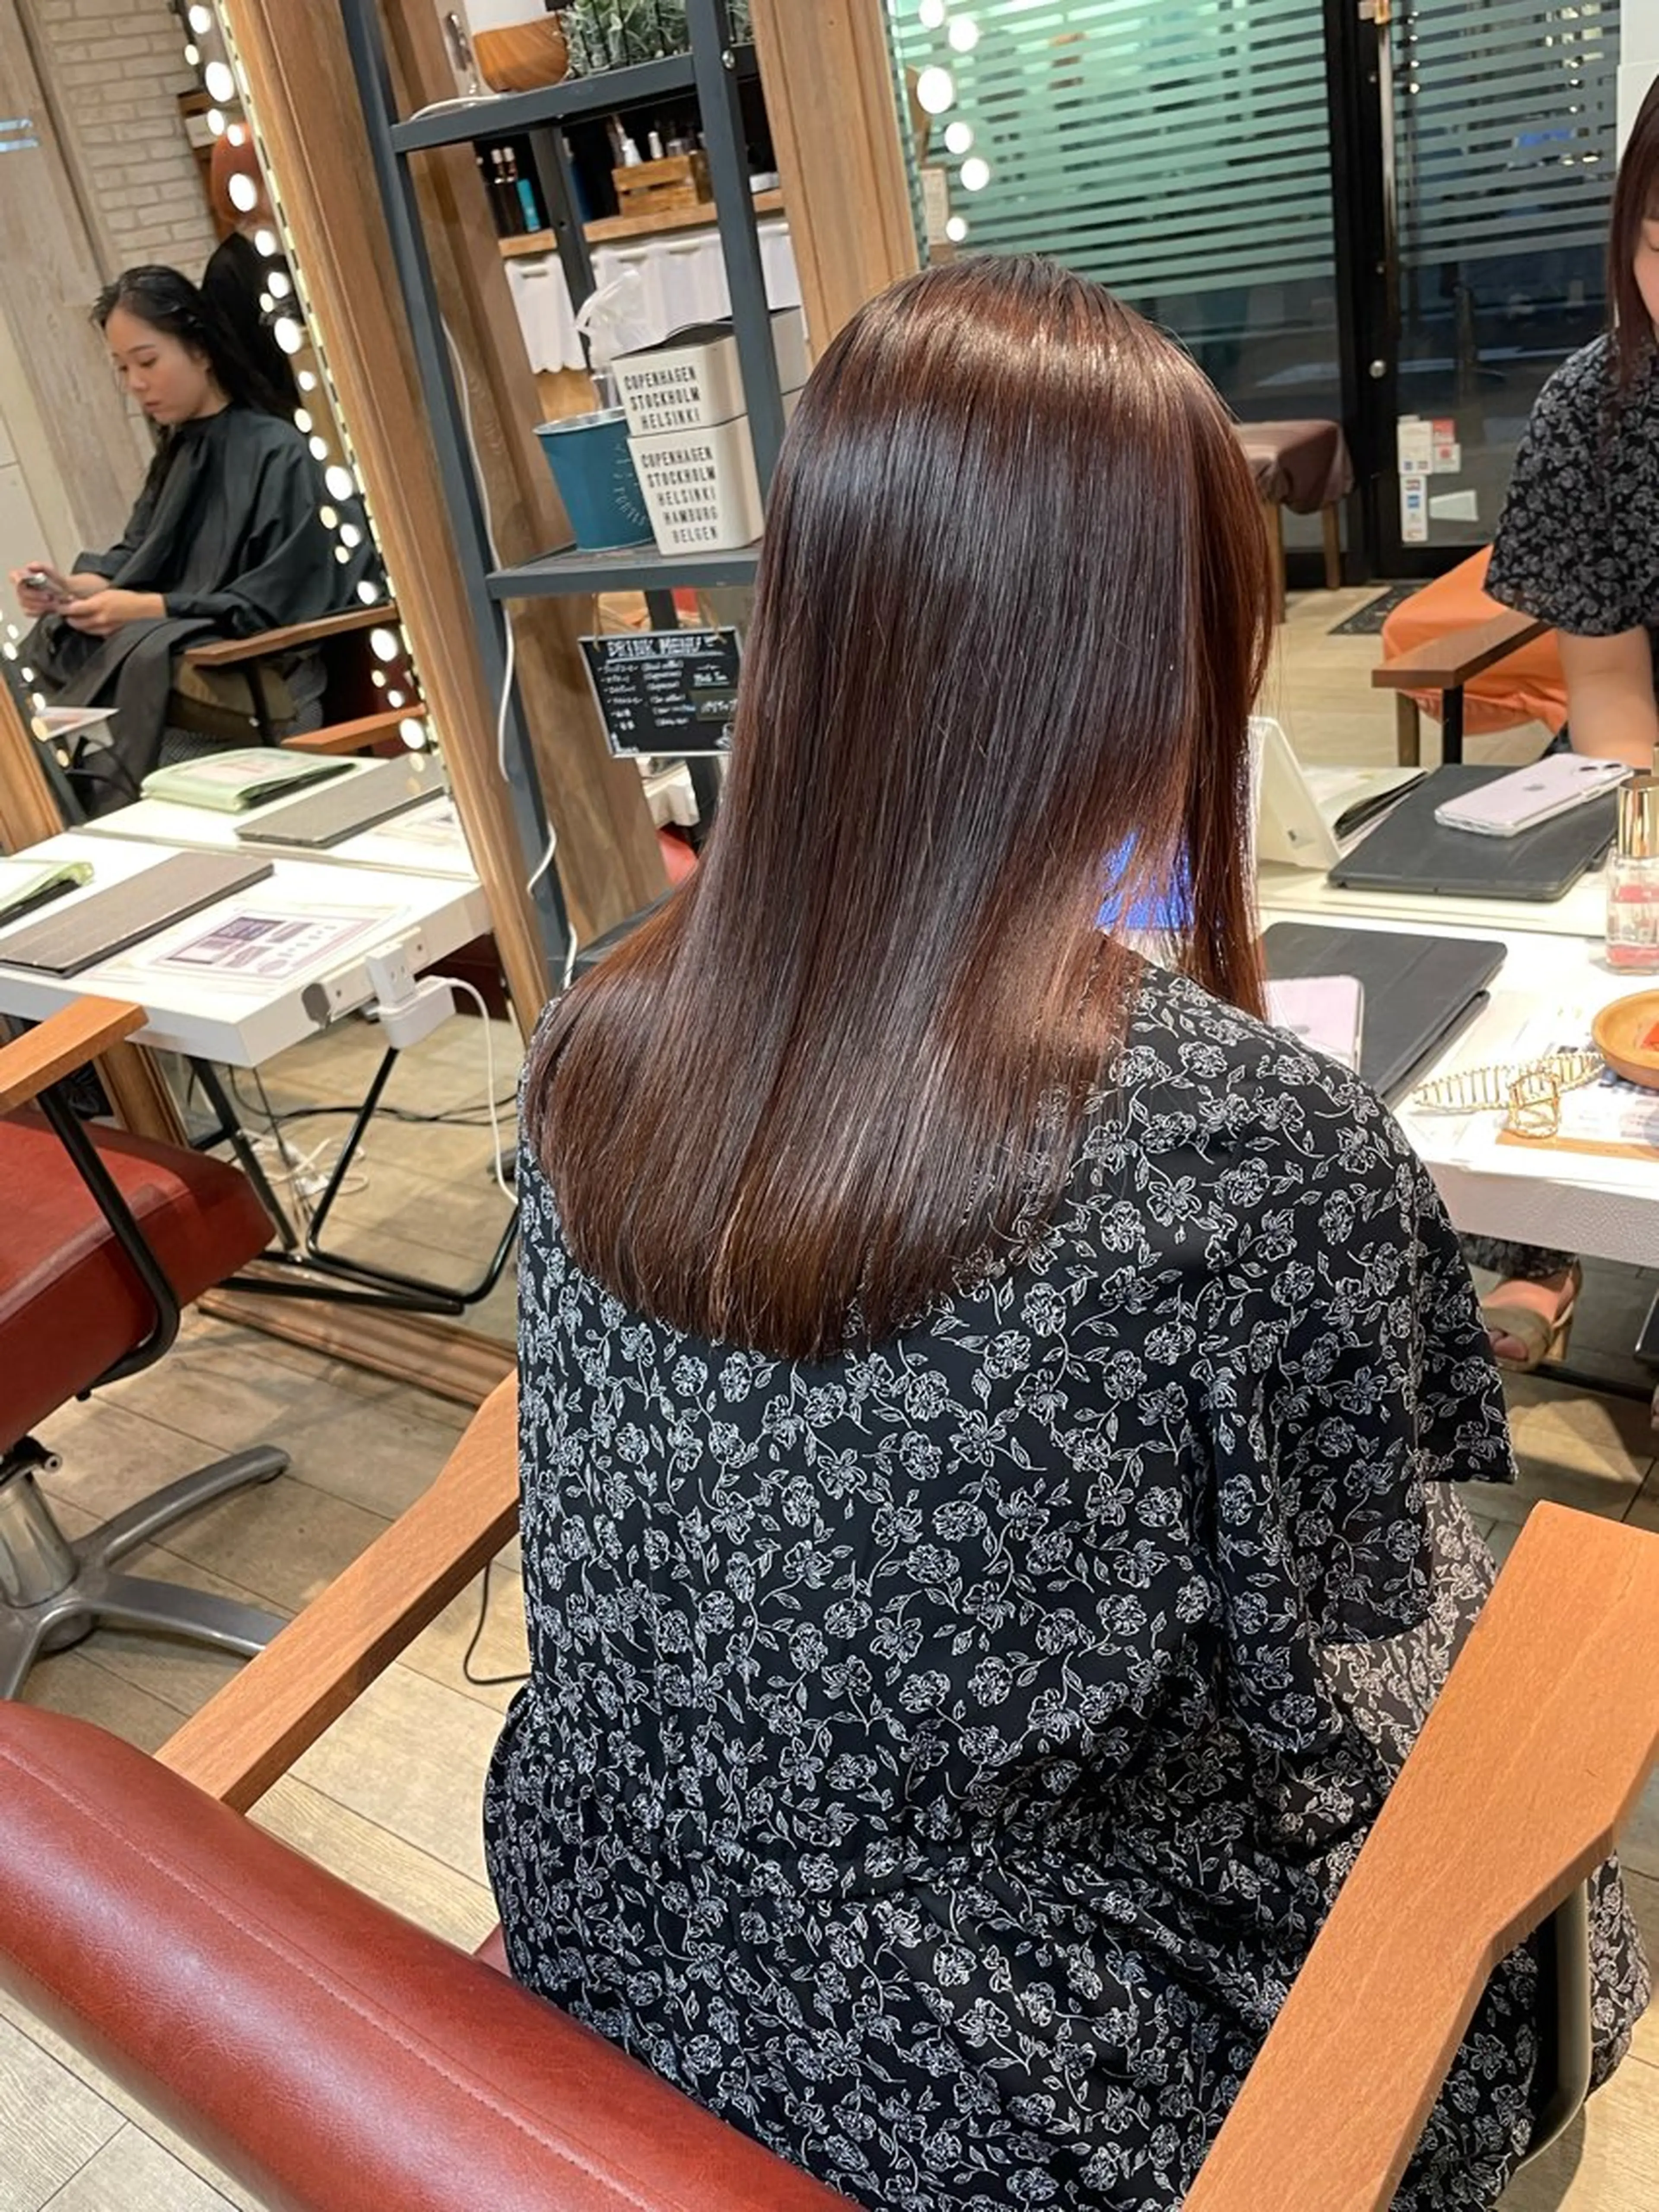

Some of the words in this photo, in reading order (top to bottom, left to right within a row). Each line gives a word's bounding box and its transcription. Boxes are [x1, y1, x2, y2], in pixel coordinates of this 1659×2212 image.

[624, 365, 696, 390] COPENHAGEN
[629, 386, 701, 411] STOCKHOLM
[641, 407, 700, 429] HELSINKI
[641, 446, 713, 468] COPENHAGEN
[647, 466, 716, 488] STOCKHOLM
[658, 486, 716, 506] HELSINKI
[663, 505, 718, 525] HAMBURG
[659, 636, 702, 654] MENU
